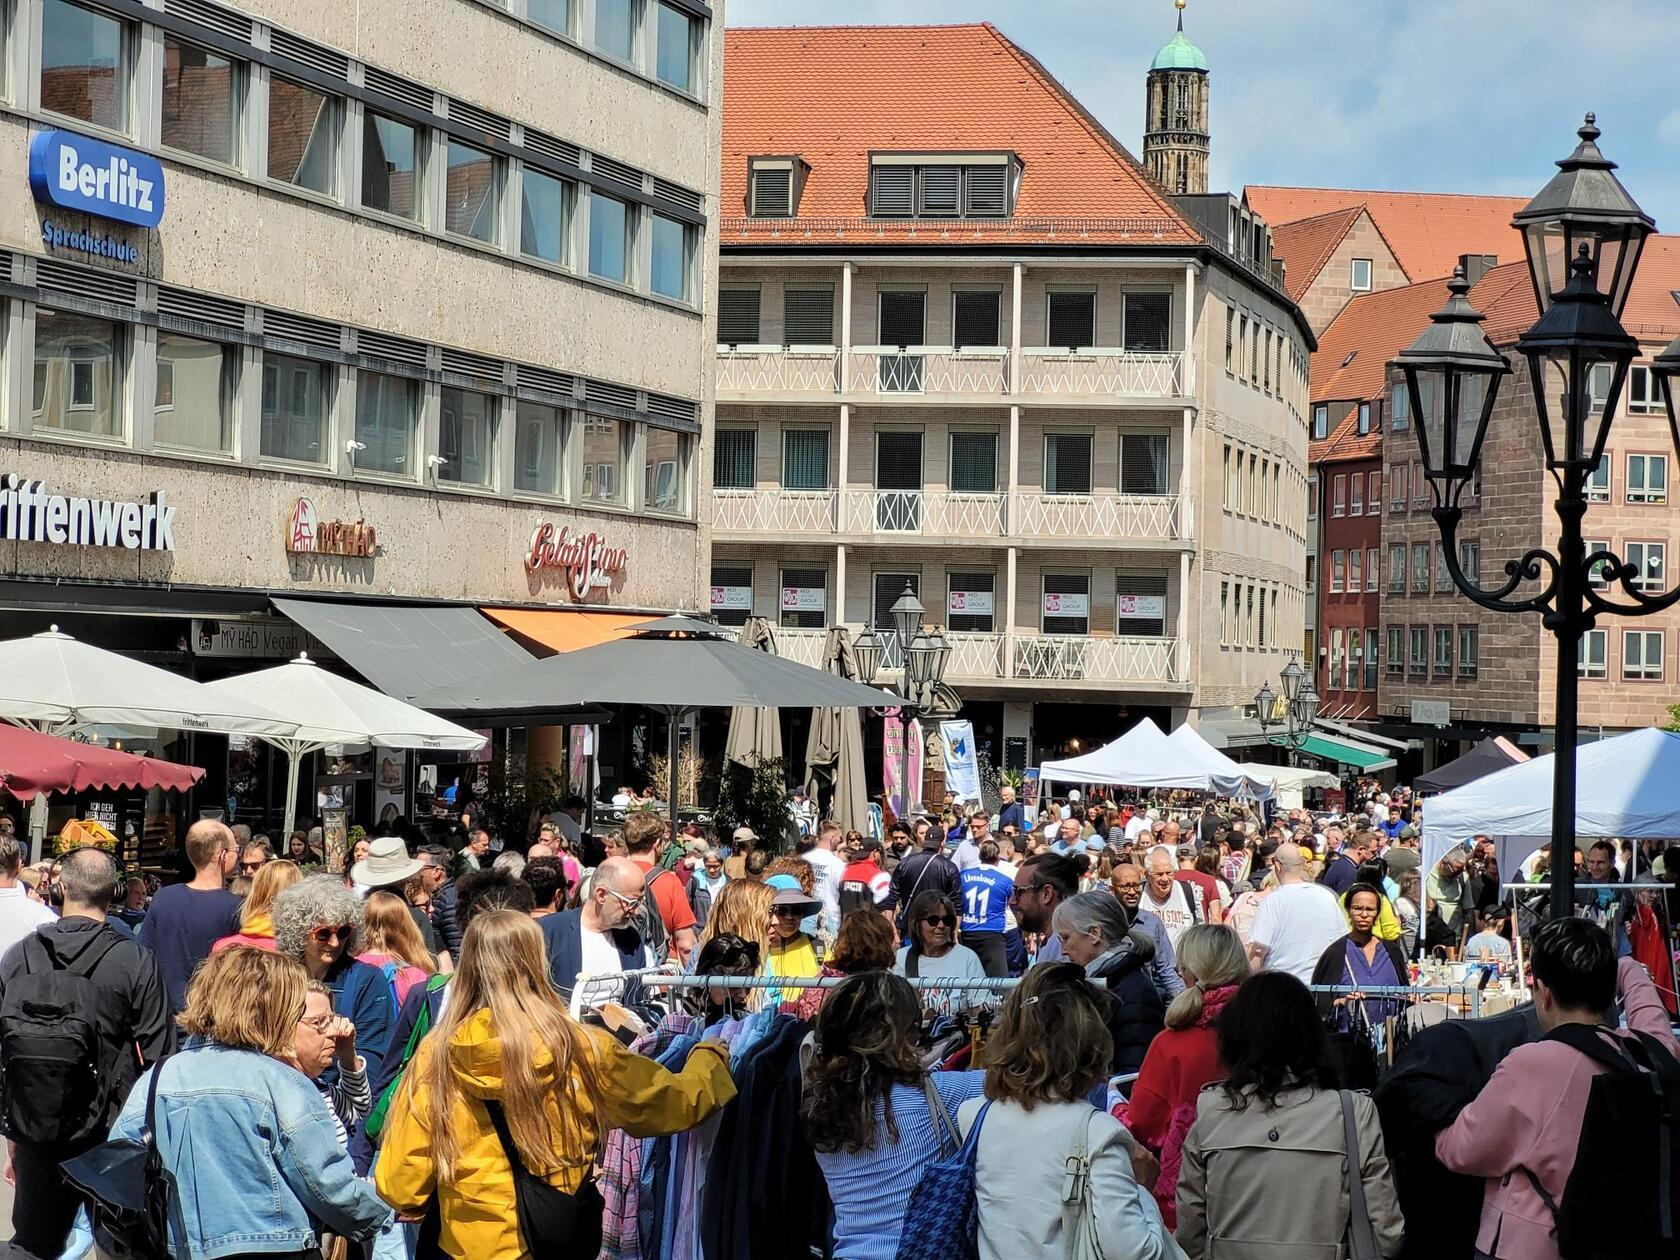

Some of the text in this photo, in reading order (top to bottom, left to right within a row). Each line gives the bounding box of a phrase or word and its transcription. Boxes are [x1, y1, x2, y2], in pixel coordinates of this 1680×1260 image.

[59, 144, 154, 213] Berlitz
[43, 220, 139, 262] Sprachschule
[221, 626, 236, 649] MỸ
[239, 626, 258, 649] HẢO
[263, 631, 298, 655] Vegan
[85, 810, 117, 821] HIER NICHT
[965, 885, 990, 917] 11
